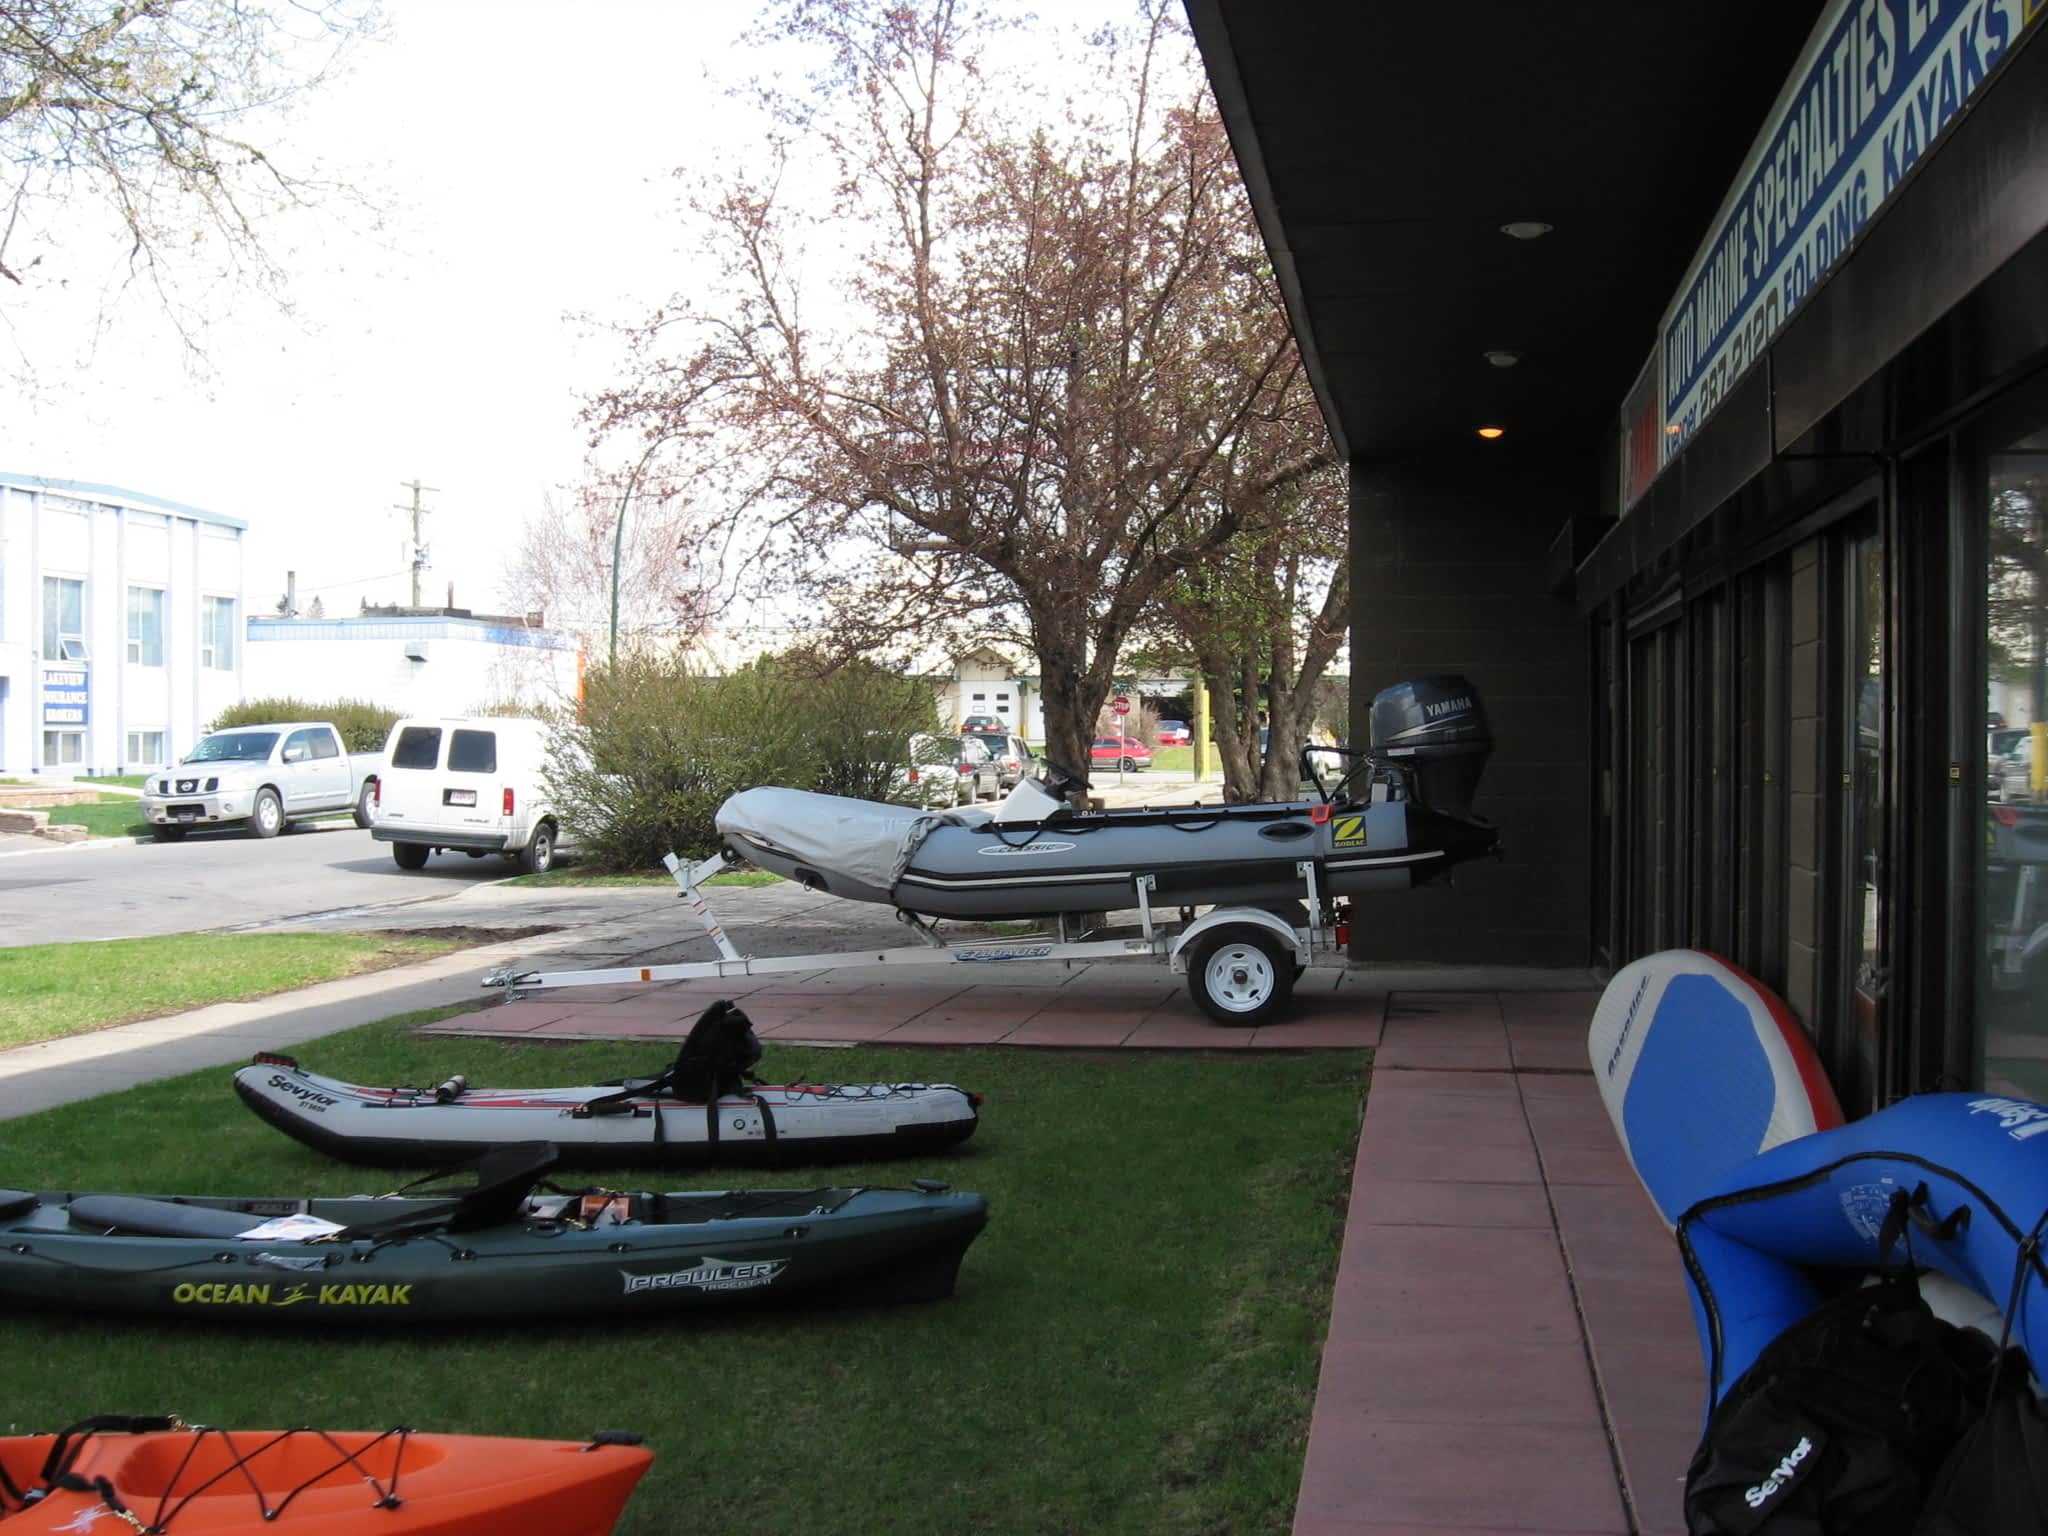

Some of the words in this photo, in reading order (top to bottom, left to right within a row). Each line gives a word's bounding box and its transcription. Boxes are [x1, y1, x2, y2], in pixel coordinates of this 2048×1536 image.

[1784, 168, 1868, 319] FOLDING
[1883, 0, 2009, 200] KAYAKS
[1668, 301, 1695, 406] AUTO
[1697, 204, 1749, 364] MARINE
[1753, 0, 1896, 279] SPECIALTIES
[1426, 696, 1473, 717] YAMAHA
[268, 1075, 340, 1105] Sevylor
[630, 1263, 772, 1290] PROWLER
[173, 1283, 271, 1305] OCEAN
[318, 1284, 412, 1305] KAYAK
